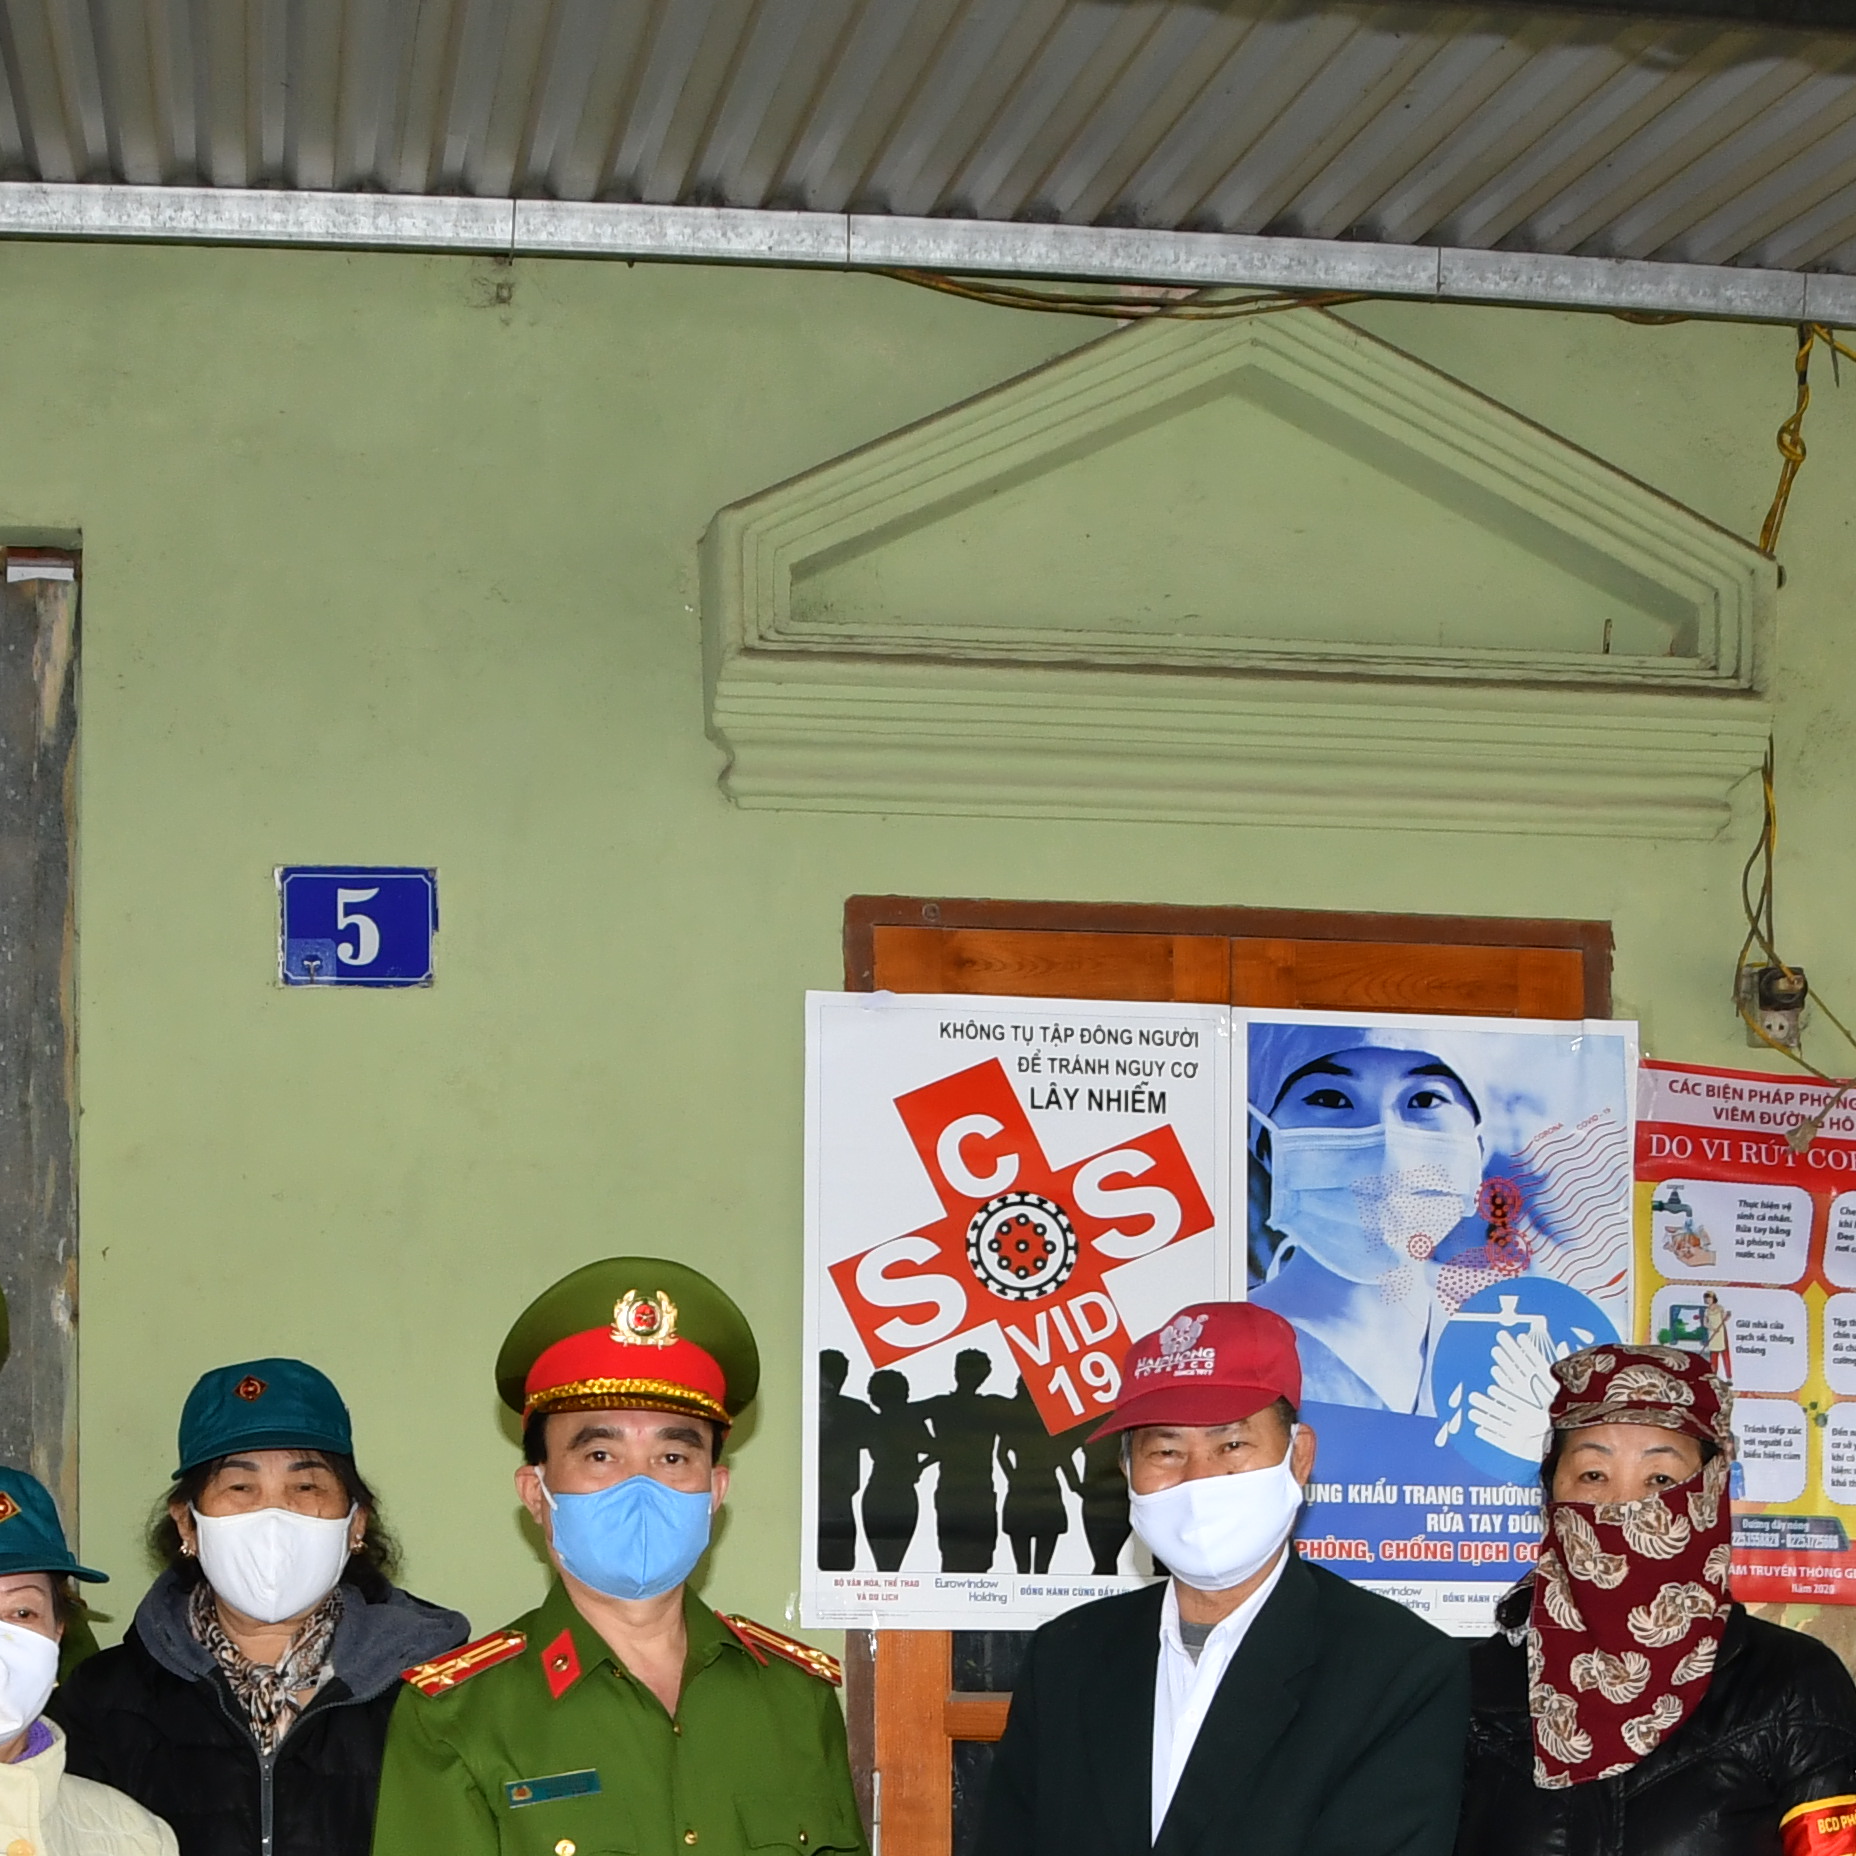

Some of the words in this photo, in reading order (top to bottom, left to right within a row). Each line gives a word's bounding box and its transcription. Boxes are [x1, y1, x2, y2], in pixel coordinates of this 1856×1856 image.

[337, 887, 380, 966] 5
[940, 1021, 1005, 1041] KHÔNG
[1011, 1025, 1034, 1046] TỤ
[1040, 1023, 1074, 1047] TẬP
[1080, 1025, 1133, 1045] ĐÔNG
[1139, 1027, 1199, 1048] NGƯỜI
[1017, 1049, 1041, 1073] ĐỂ
[1047, 1055, 1109, 1075] TRÁNH
[1115, 1060, 1166, 1078] NGUY
[1170, 1061, 1199, 1079] CƠ
[1030, 1082, 1080, 1110] LÂY
[1087, 1080, 1167, 1114] NHIỄM
[1668, 1078, 1702, 1096] CÁC
[1705, 1084, 1744, 1103] BIỆN
[1747, 1087, 1795, 1106] PHÁP
[1713, 1104, 1756, 1123] VIÊM
[1829, 1116, 1854, 1132] HÔ
[1648, 1133, 1692, 1158] DO
[1700, 1138, 1732, 1161] VI
[1739, 1140, 1799, 1167] RÚT
[1047, 1358, 1121, 1416] 19
[1305, 1483, 1343, 1504] ỤNG
[1347, 1477, 1398, 1505] KHẨU
[1403, 1485, 1465, 1506] TRANG
[1469, 1482, 1543, 1507] THƯỜNG
[1426, 1506, 1465, 1533] RỬA
[1469, 1513, 1504, 1534] TAY
[1508, 1510, 1544, 1534] ĐÚN
[1294, 1535, 1375, 1562] PHÒNG,
[1380, 1534, 1453, 1562] CHỐNG
[1458, 1542, 1510, 1566] DỊCH
[934, 1577, 999, 1589] Eurowindow
[1728, 1566, 1747, 1577] ÂM
[968, 1591, 1007, 1604] Holding
